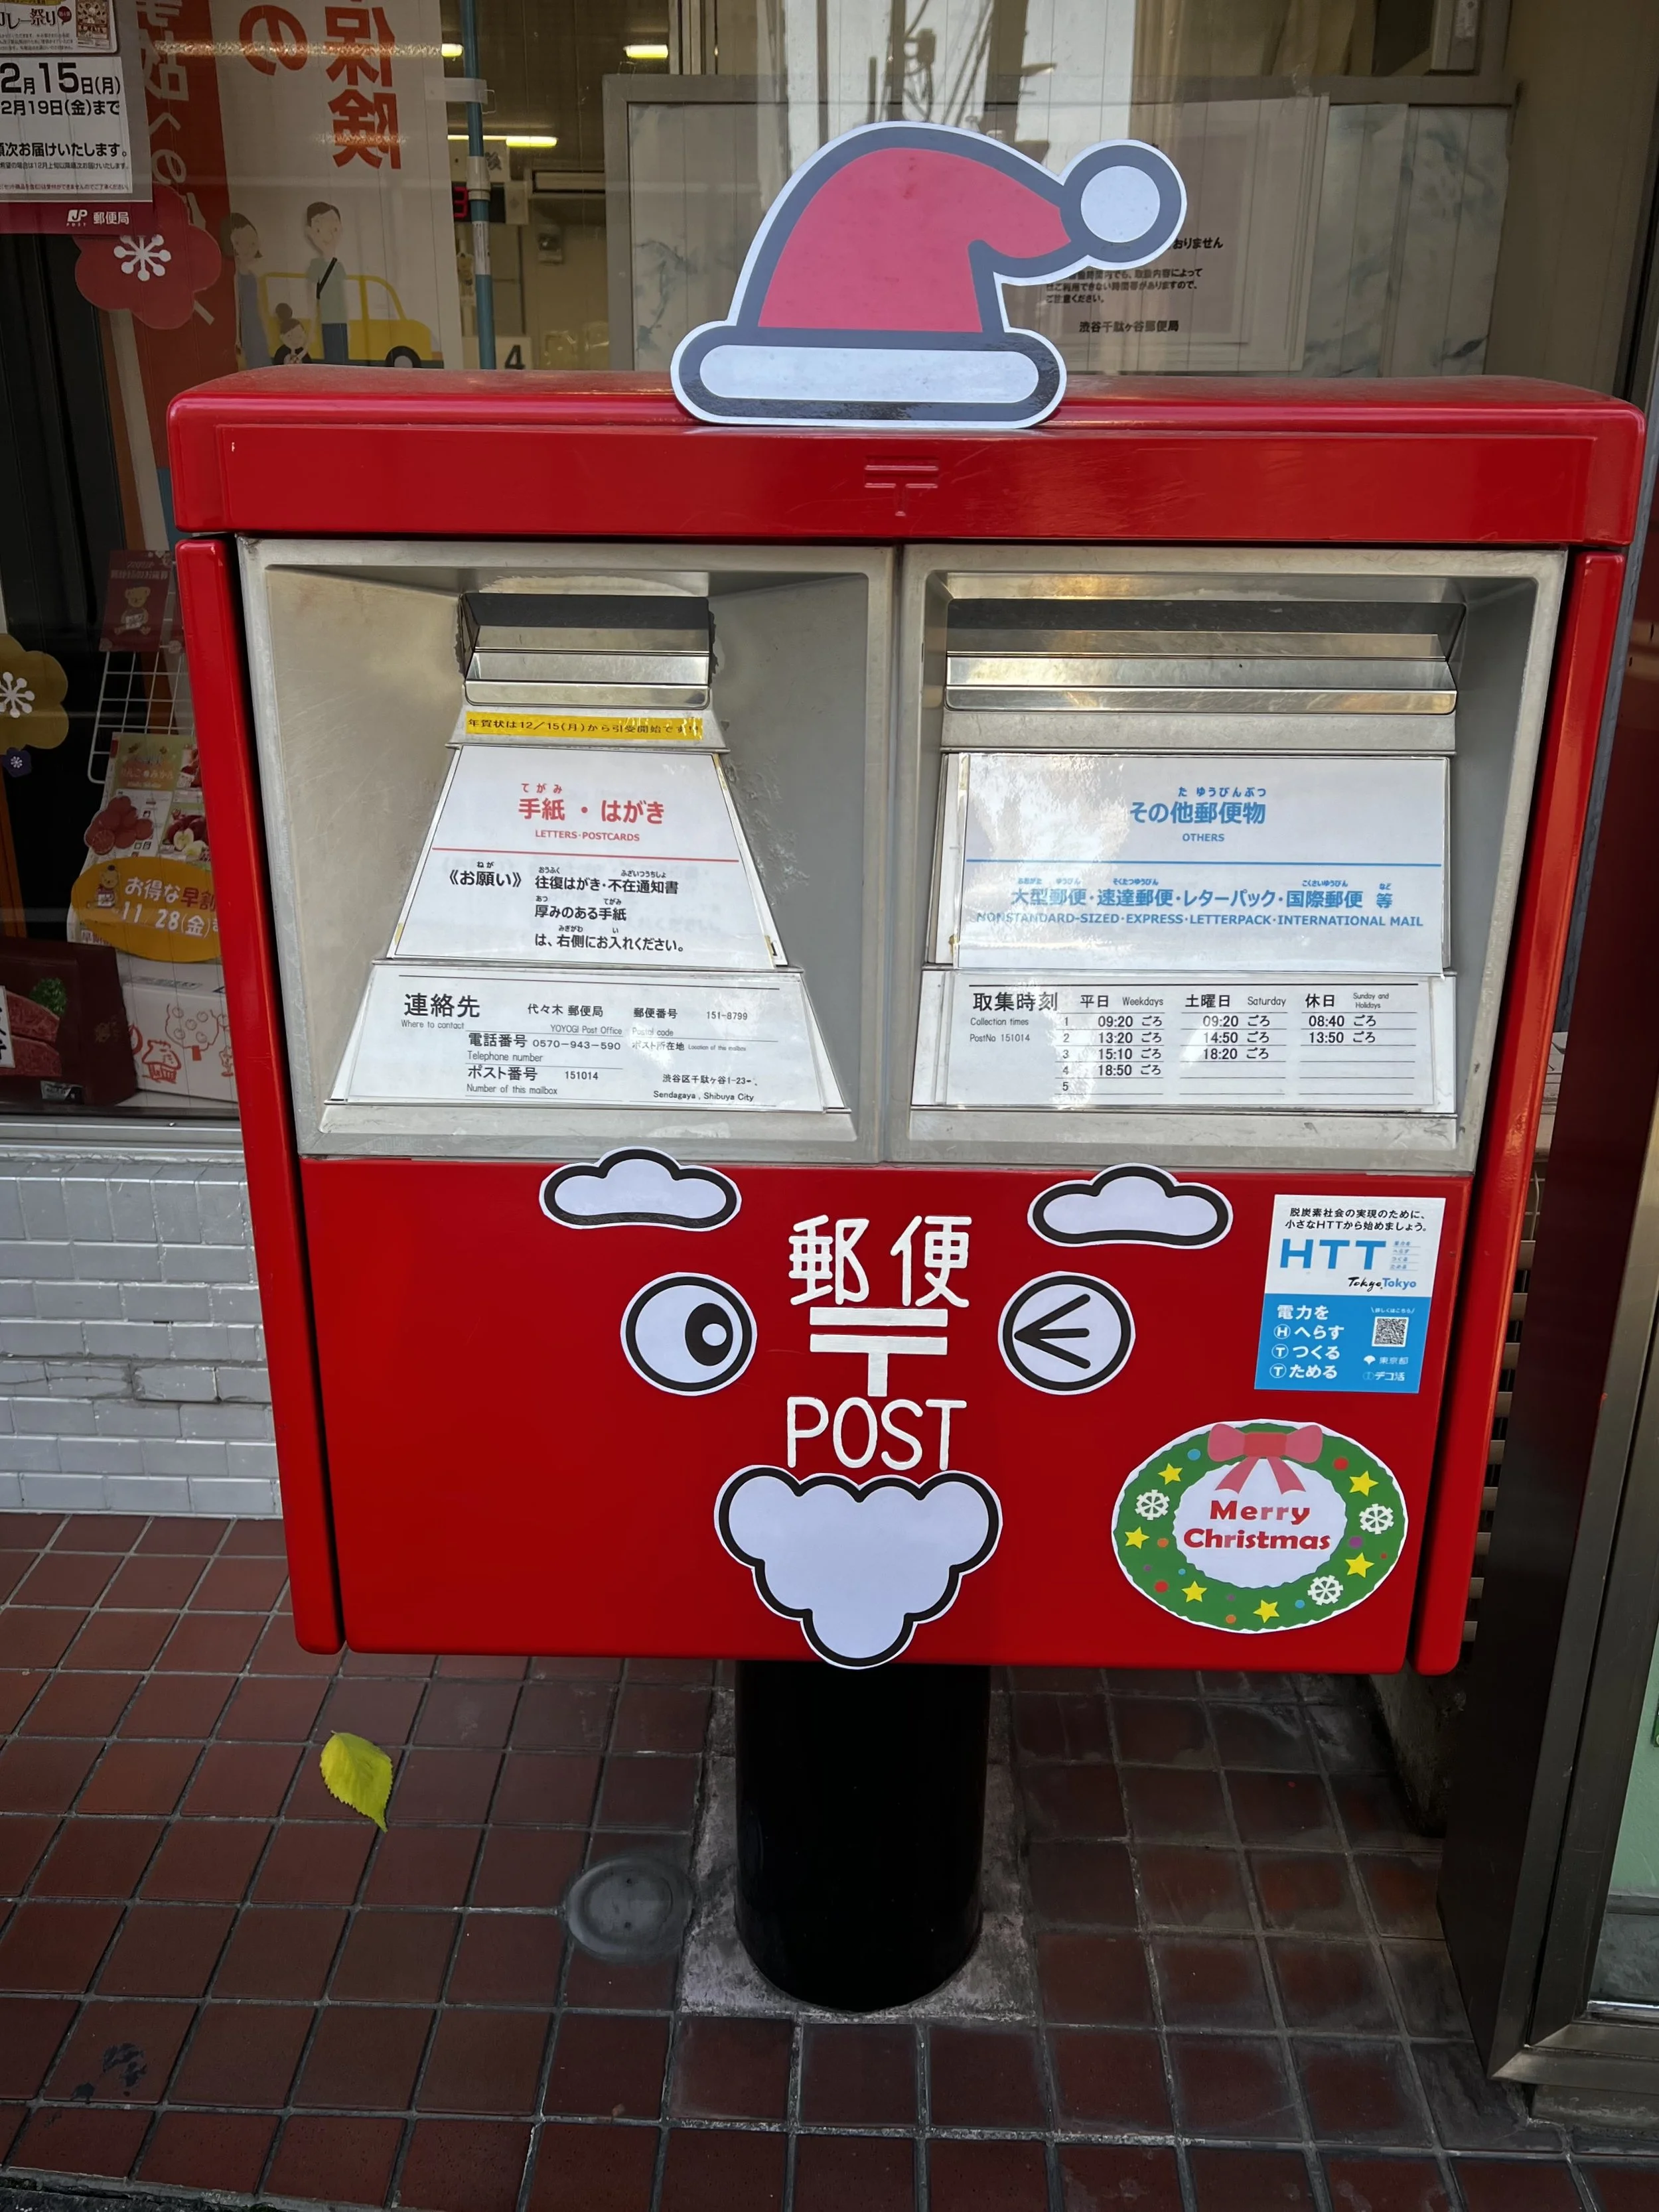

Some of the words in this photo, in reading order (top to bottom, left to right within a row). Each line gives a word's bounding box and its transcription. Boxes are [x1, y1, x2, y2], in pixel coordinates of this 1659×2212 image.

[1, 100, 120, 115] 2月19日(金)まで
[93, 212, 129, 224] 郵便局
[521, 783, 563, 794] てがみ
[1179, 787, 1187, 797] た
[1196, 787, 1266, 797] ゆうびんぶつ
[1130, 801, 1266, 824] その他郵便物
[1183, 833, 1225, 842] OTHERS
[449, 869, 522, 887] 《お願い》
[1376, 892, 1393, 908] 等
[535, 904, 626, 921] 厚みのある手紙
[1390, 916, 1423, 926] MAIL
[535, 933, 684, 952] は、右側にお入れください。
[404, 993, 480, 1018] 連絡先
[973, 992, 1058, 1012] 取集時刻
[1080, 995, 1109, 1008] 平日
[1122, 997, 1164, 1006] Weekdays
[1185, 994, 1230, 1008] 土曜日
[1248, 997, 1287, 1006] Saturday
[1305, 993, 1335, 1008] 休日
[528, 1003, 563, 1015] 代々木
[567, 1004, 603, 1017] 郵便局
[634, 1007, 678, 1019] 郵便番号
[707, 1011, 748, 1020] 151-8799
[401, 1019, 424, 1028] Where
[427, 1020, 435, 1029] to
[970, 1017, 1007, 1026] Collection
[1010, 1017, 1029, 1026] times
[1064, 1016, 1069, 1026] 1
[1098, 1016, 1133, 1028] 09:20
[1141, 1016, 1163, 1026] ごろ
[1202, 1015, 1239, 1027] 09:20
[1247, 1015, 1270, 1026] ごろ
[1308, 1016, 1344, 1027] 08:40
[1353, 1014, 1376, 1026] ごろ
[550, 1024, 579, 1034] YOYOGI
[582, 1025, 597, 1034] Post
[600, 1026, 622, 1035] Office
[632, 1027, 654, 1036] Postal
[657, 1028, 674, 1037] code
[469, 1032, 528, 1048] 電話番号
[970, 1034, 996, 1042] PostNo
[1001, 1034, 1030, 1042] 151014
[1062, 1032, 1069, 1043] 2
[1098, 1032, 1133, 1044] 13:20
[1141, 1032, 1162, 1043] ごろ
[1203, 1032, 1238, 1044] 14:50
[1246, 1031, 1269, 1043] ごろ
[1309, 1032, 1344, 1044] 13:50
[1352, 1031, 1376, 1043] ごろ
[632, 1041, 685, 1051] ポスト所在地
[467, 1050, 509, 1062] Telephone
[512, 1053, 543, 1062] number
[1062, 1049, 1069, 1059] 3
[1098, 1048, 1133, 1060] 15:10
[1140, 1048, 1162, 1059] ごろ
[1202, 1048, 1238, 1060] 18:20
[1246, 1048, 1269, 1059] ごろ
[468, 1064, 538, 1081] ポスト番号
[565, 1071, 599, 1080] 151014
[1062, 1066, 1069, 1075] 4
[1098, 1064, 1132, 1076] 18:50
[1140, 1064, 1161, 1075] ごろ
[662, 1074, 757, 1086] 渋谷区千駄ヶ谷1-23-
[1062, 1081, 1068, 1091] 5
[467, 1083, 496, 1093] Number
[500, 1085, 508, 1093] of
[529, 1086, 557, 1095] mailbox
[703, 1092, 735, 1101] Shibuya
[737, 1093, 754, 1102] City
[1289, 1208, 1425, 1219] 脱炭素社会の実現のために、
[1285, 1219, 1427, 1232] 小さなHTTから始めましょう。
[1280, 1238, 1387, 1270] HTT
[788, 1214, 972, 1308] 郵便
[1277, 1304, 1329, 1320] 電力を
[1294, 1326, 1344, 1340] へらす
[1293, 1345, 1340, 1360] つくる
[1289, 1364, 1338, 1379] ためる
[1375, 1371, 1405, 1381] デコ活
[787, 1397, 967, 1471] POST
[1210, 1500, 1310, 1525] Merry
[1183, 1528, 1331, 1550] Christmas
